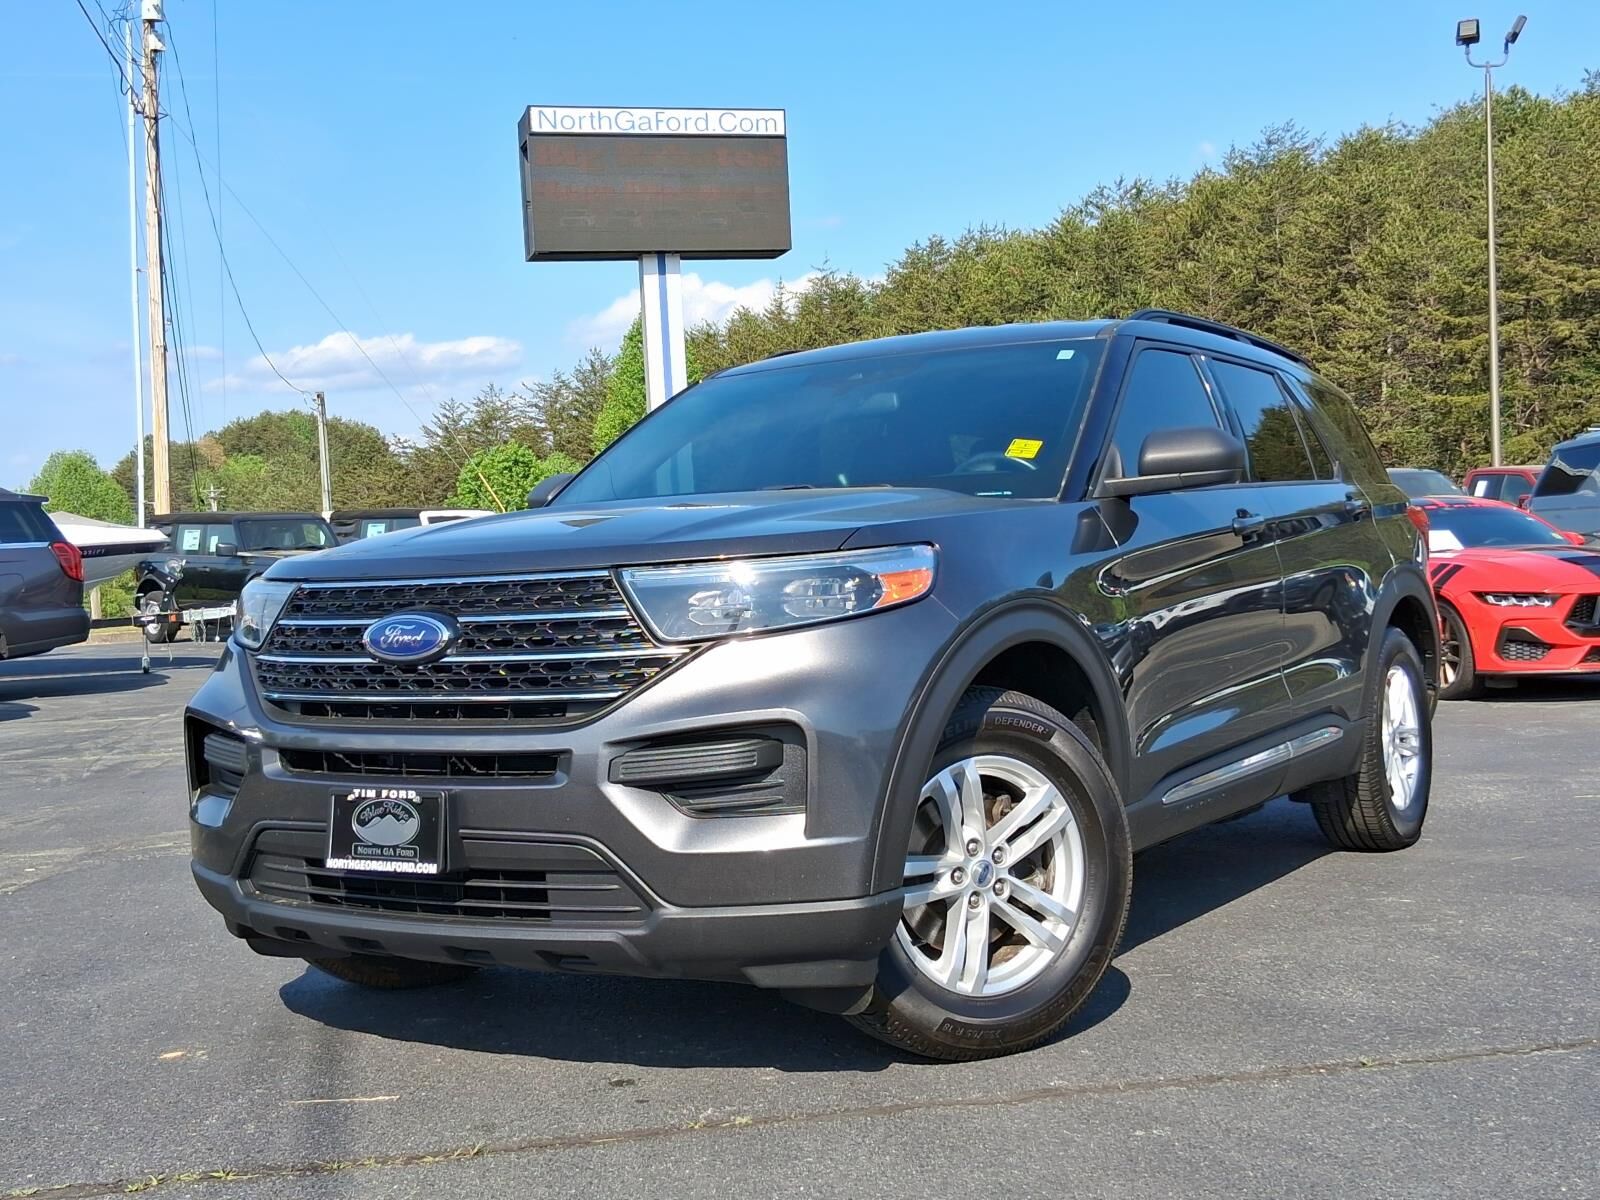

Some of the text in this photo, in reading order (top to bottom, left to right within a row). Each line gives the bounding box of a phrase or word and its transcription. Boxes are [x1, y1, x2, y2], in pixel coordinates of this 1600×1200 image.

[537, 109, 778, 133] NorthGaFord.Com
[380, 623, 426, 648] Ford
[381, 789, 416, 799] FORD
[360, 801, 410, 822] Blue Ridge
[382, 847, 395, 856] GA
[326, 858, 438, 874] NORTHGEORGIAFORD.COM
